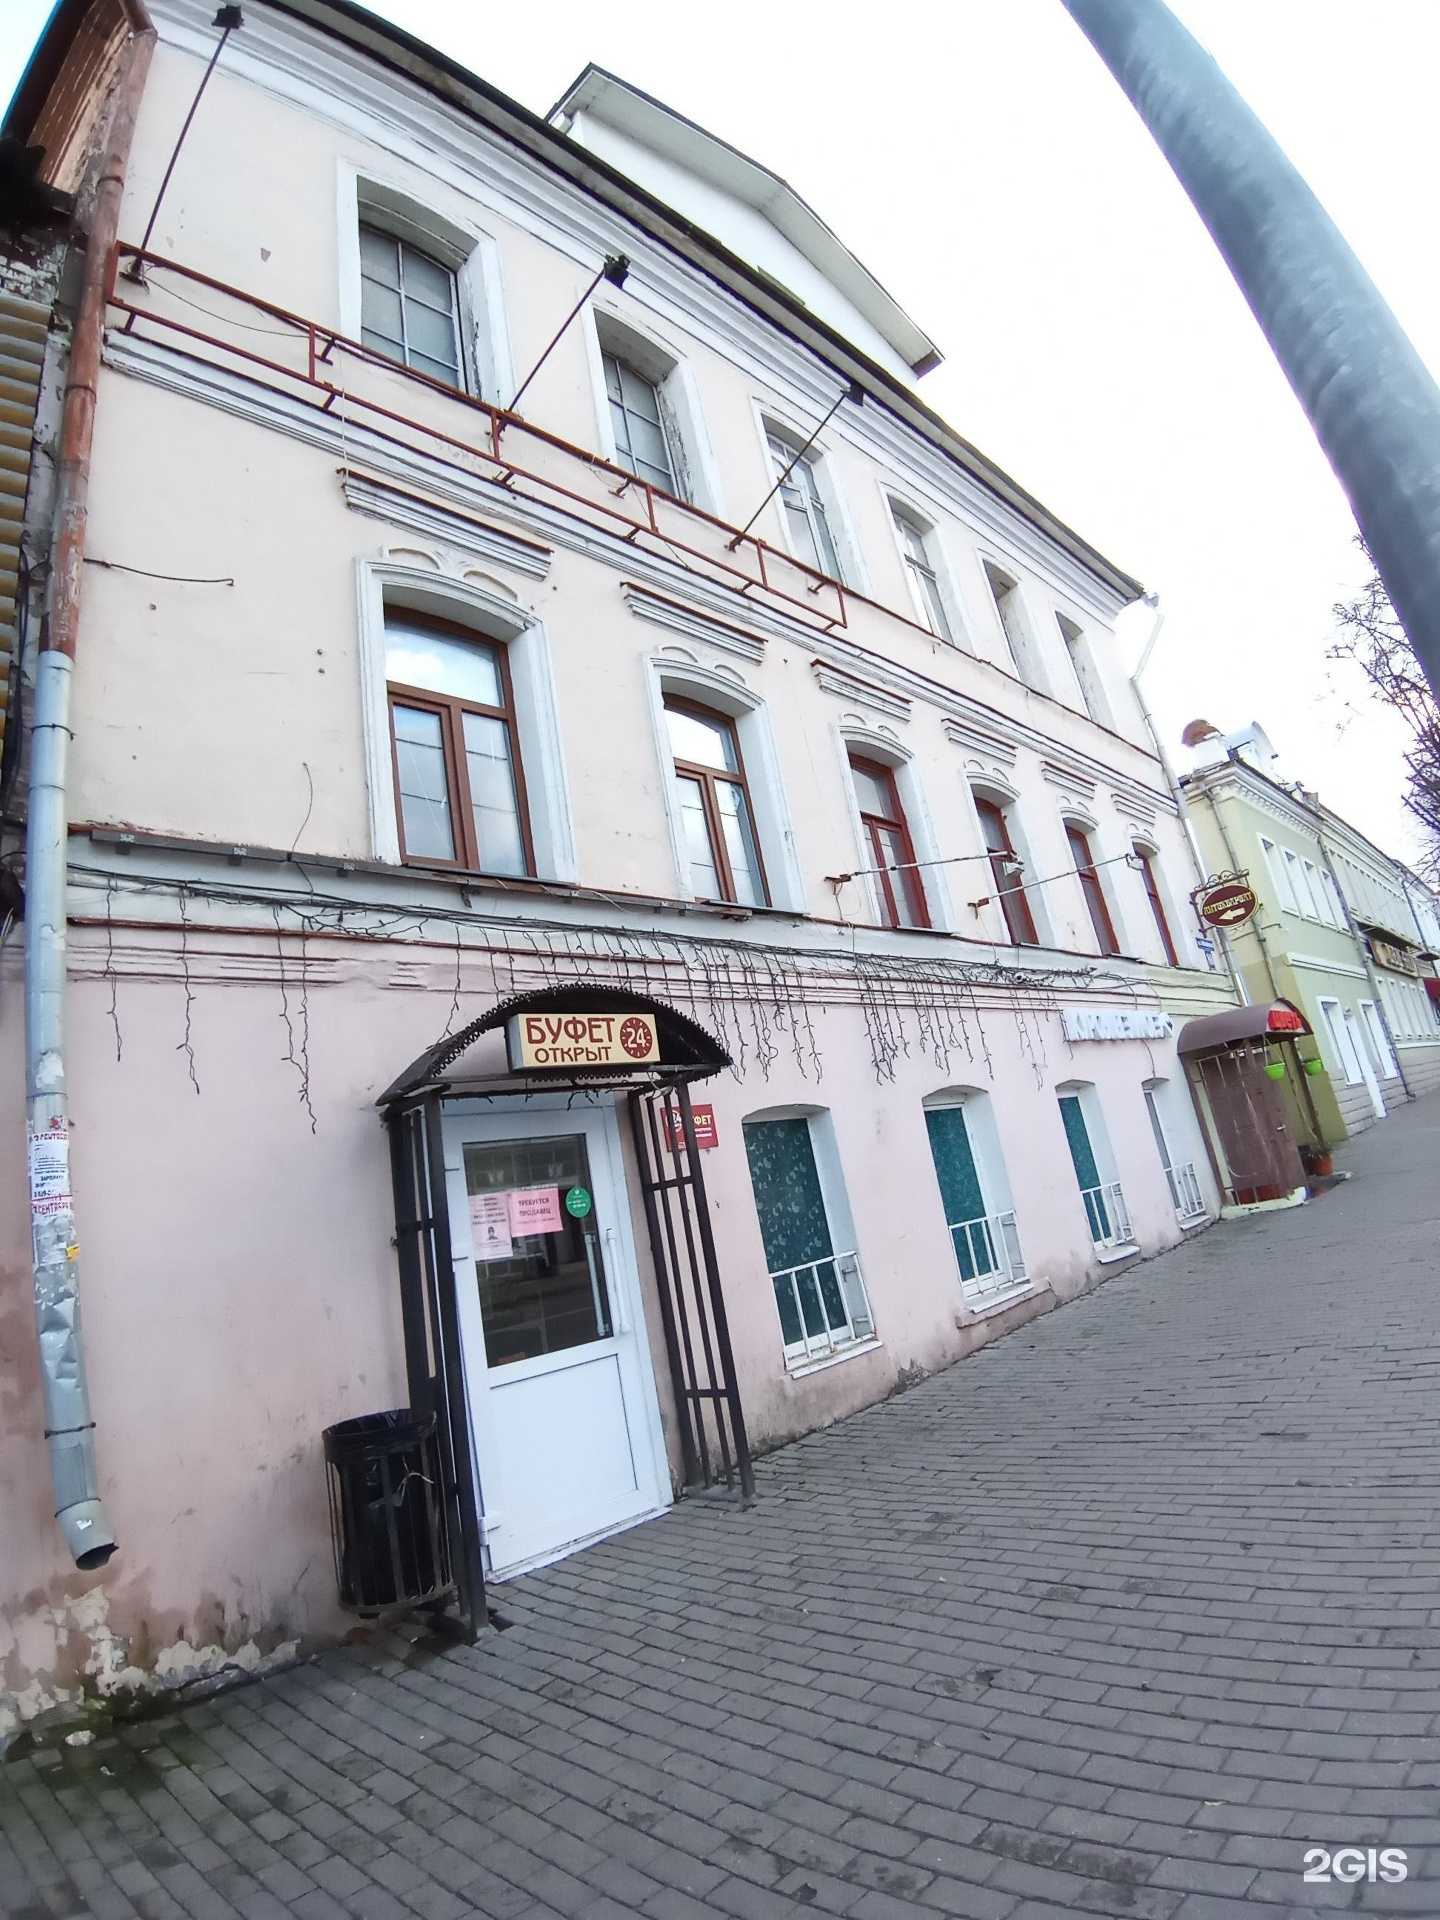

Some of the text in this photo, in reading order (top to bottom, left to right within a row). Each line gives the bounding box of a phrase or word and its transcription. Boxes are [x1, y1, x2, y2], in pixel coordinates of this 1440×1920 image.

[525, 1016, 616, 1045] БУФЕТ
[626, 1027, 647, 1048] 24
[534, 1046, 612, 1063] ОТКРЫТ
